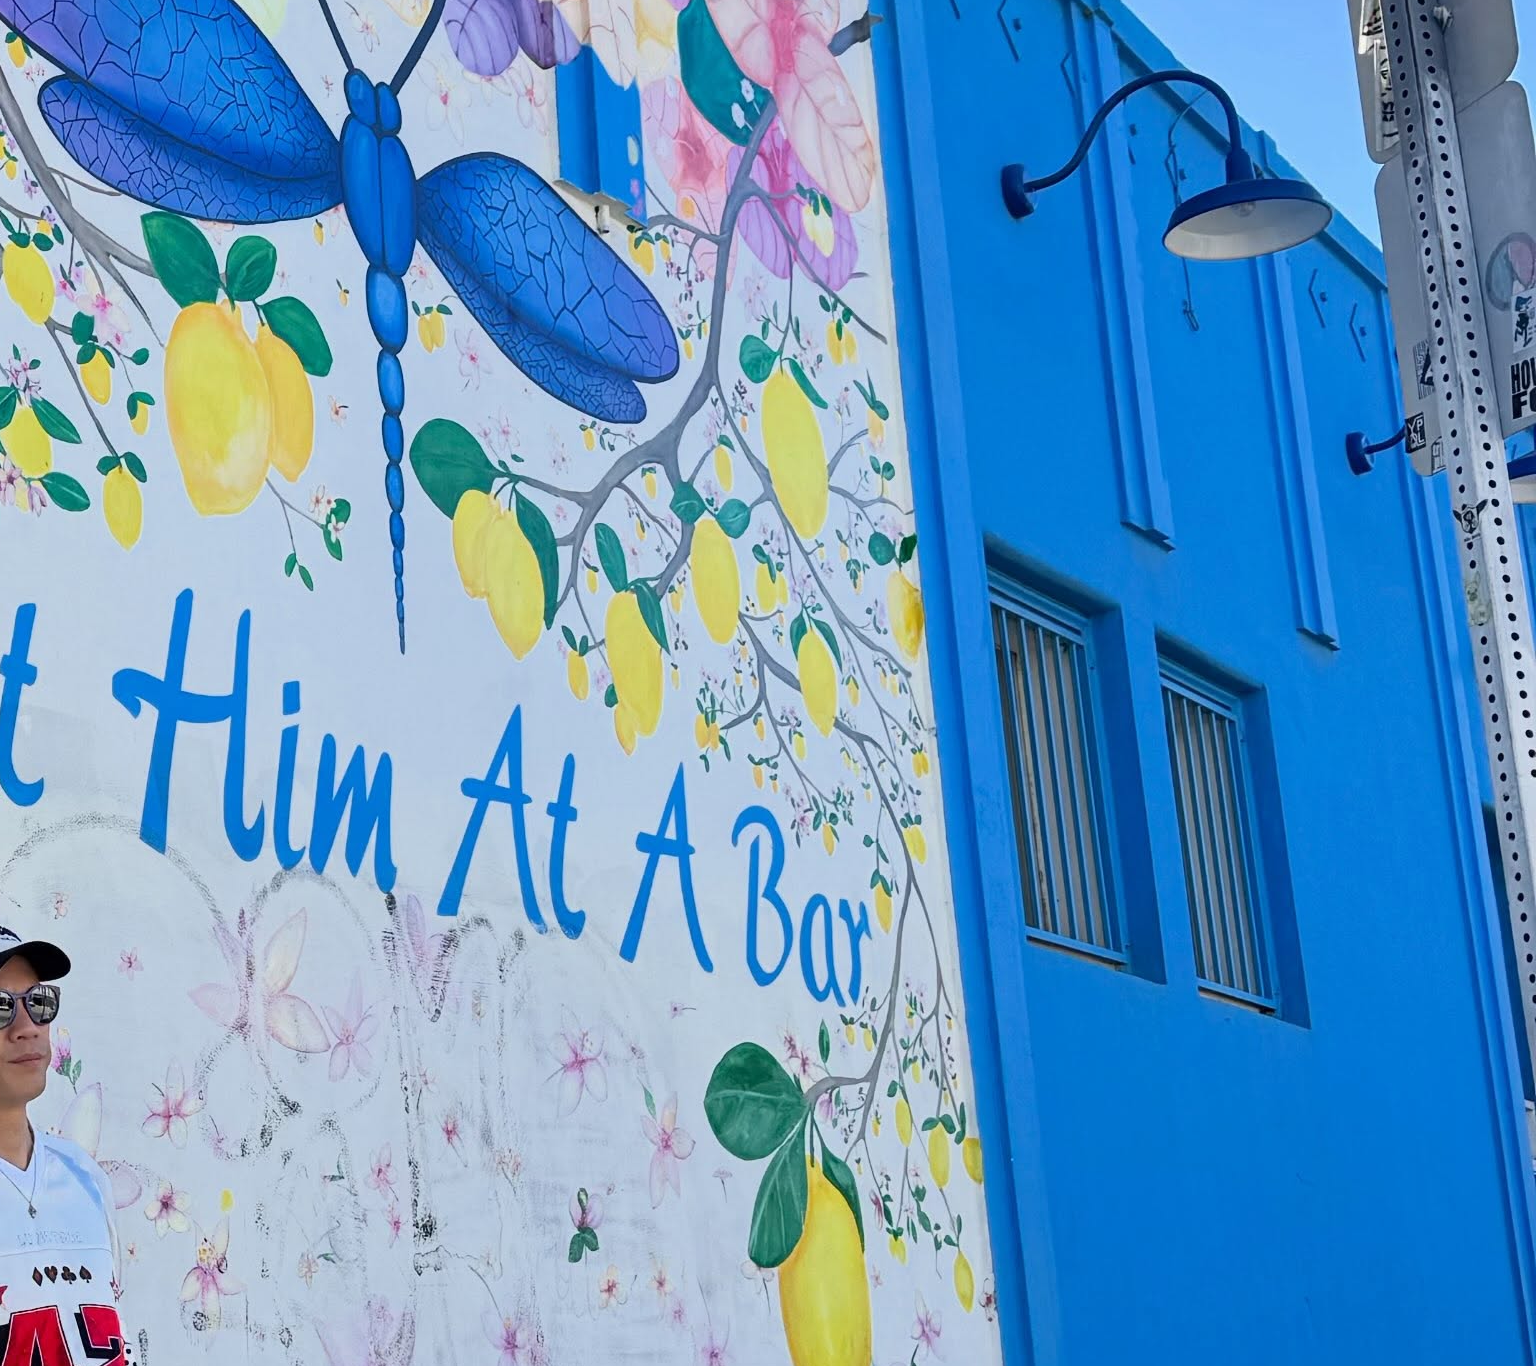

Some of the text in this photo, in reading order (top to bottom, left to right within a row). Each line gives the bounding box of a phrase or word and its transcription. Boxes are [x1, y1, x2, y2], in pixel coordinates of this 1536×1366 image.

[112, 588, 397, 894] Him
[438, 705, 586, 940] At
[620, 764, 714, 973] A
[732, 806, 873, 1006] Bar
